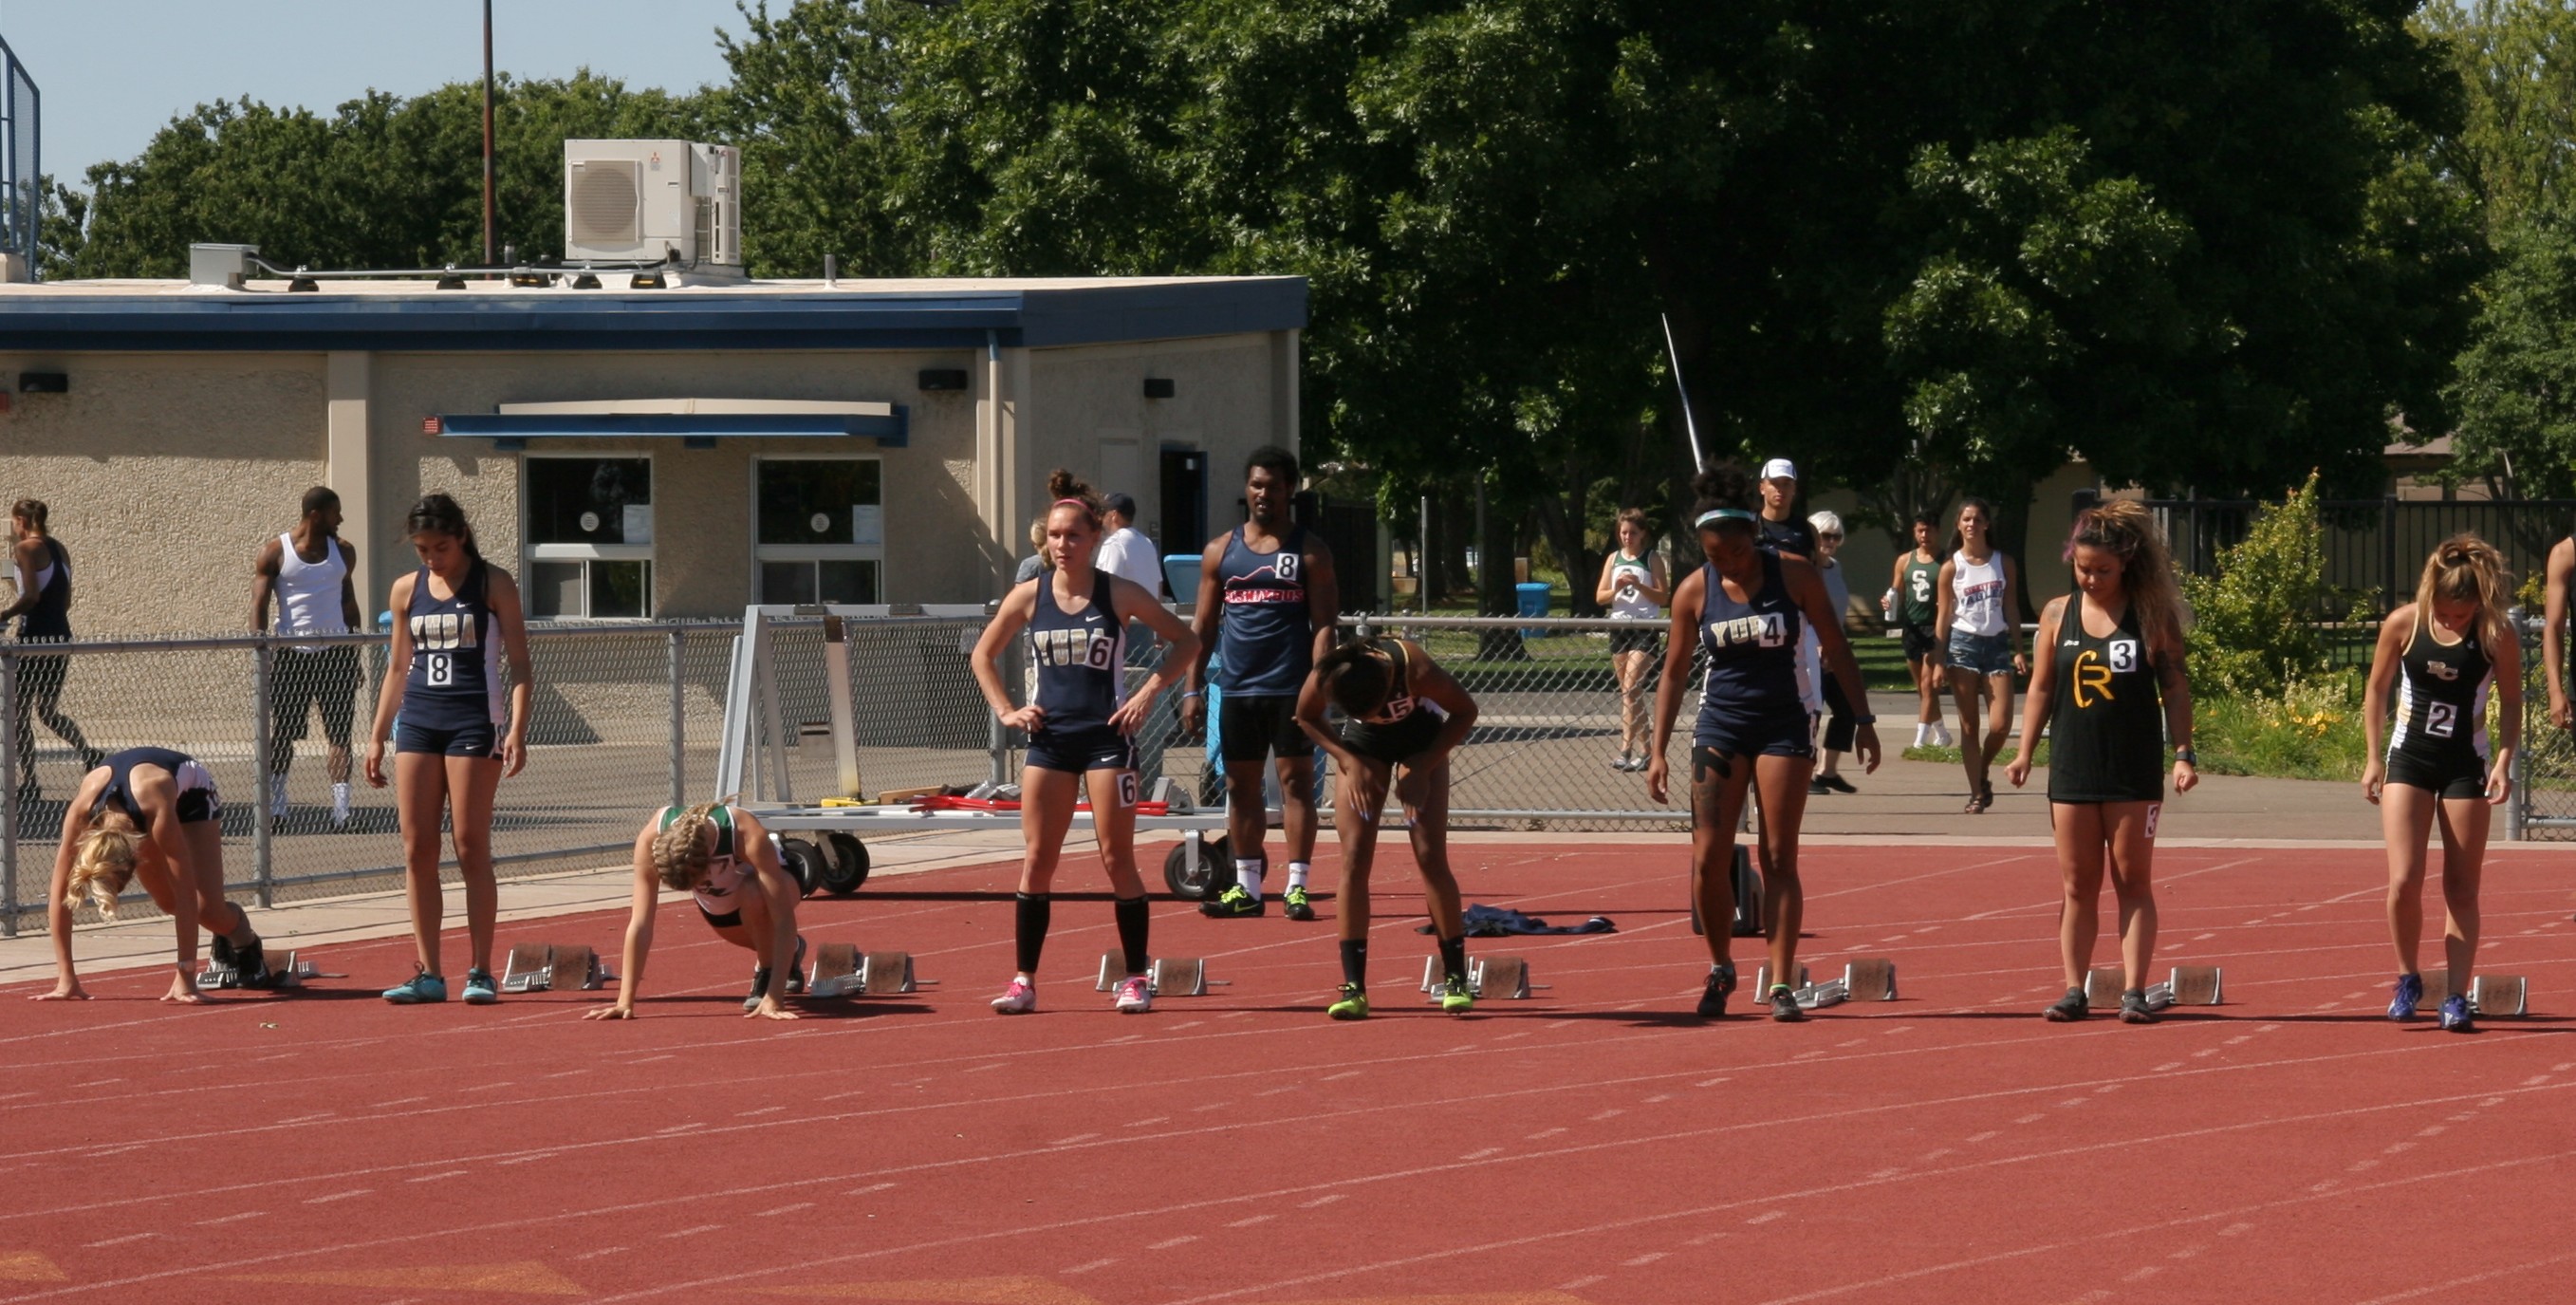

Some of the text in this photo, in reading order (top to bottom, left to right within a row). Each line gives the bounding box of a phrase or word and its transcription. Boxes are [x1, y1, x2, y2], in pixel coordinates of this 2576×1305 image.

[1280, 555, 1294, 578] 8
[1913, 569, 1930, 602] SC
[410, 614, 477, 650] YUBA
[1711, 613, 1788, 647] YUB
[1764, 616, 1781, 645] 4
[1034, 628, 1104, 666] YUB
[1089, 639, 1109, 666] 6
[2113, 643, 2132, 670] 3
[432, 655, 448, 682] 8
[2429, 704, 2452, 735] 2
[1121, 775, 1135, 804] 6
